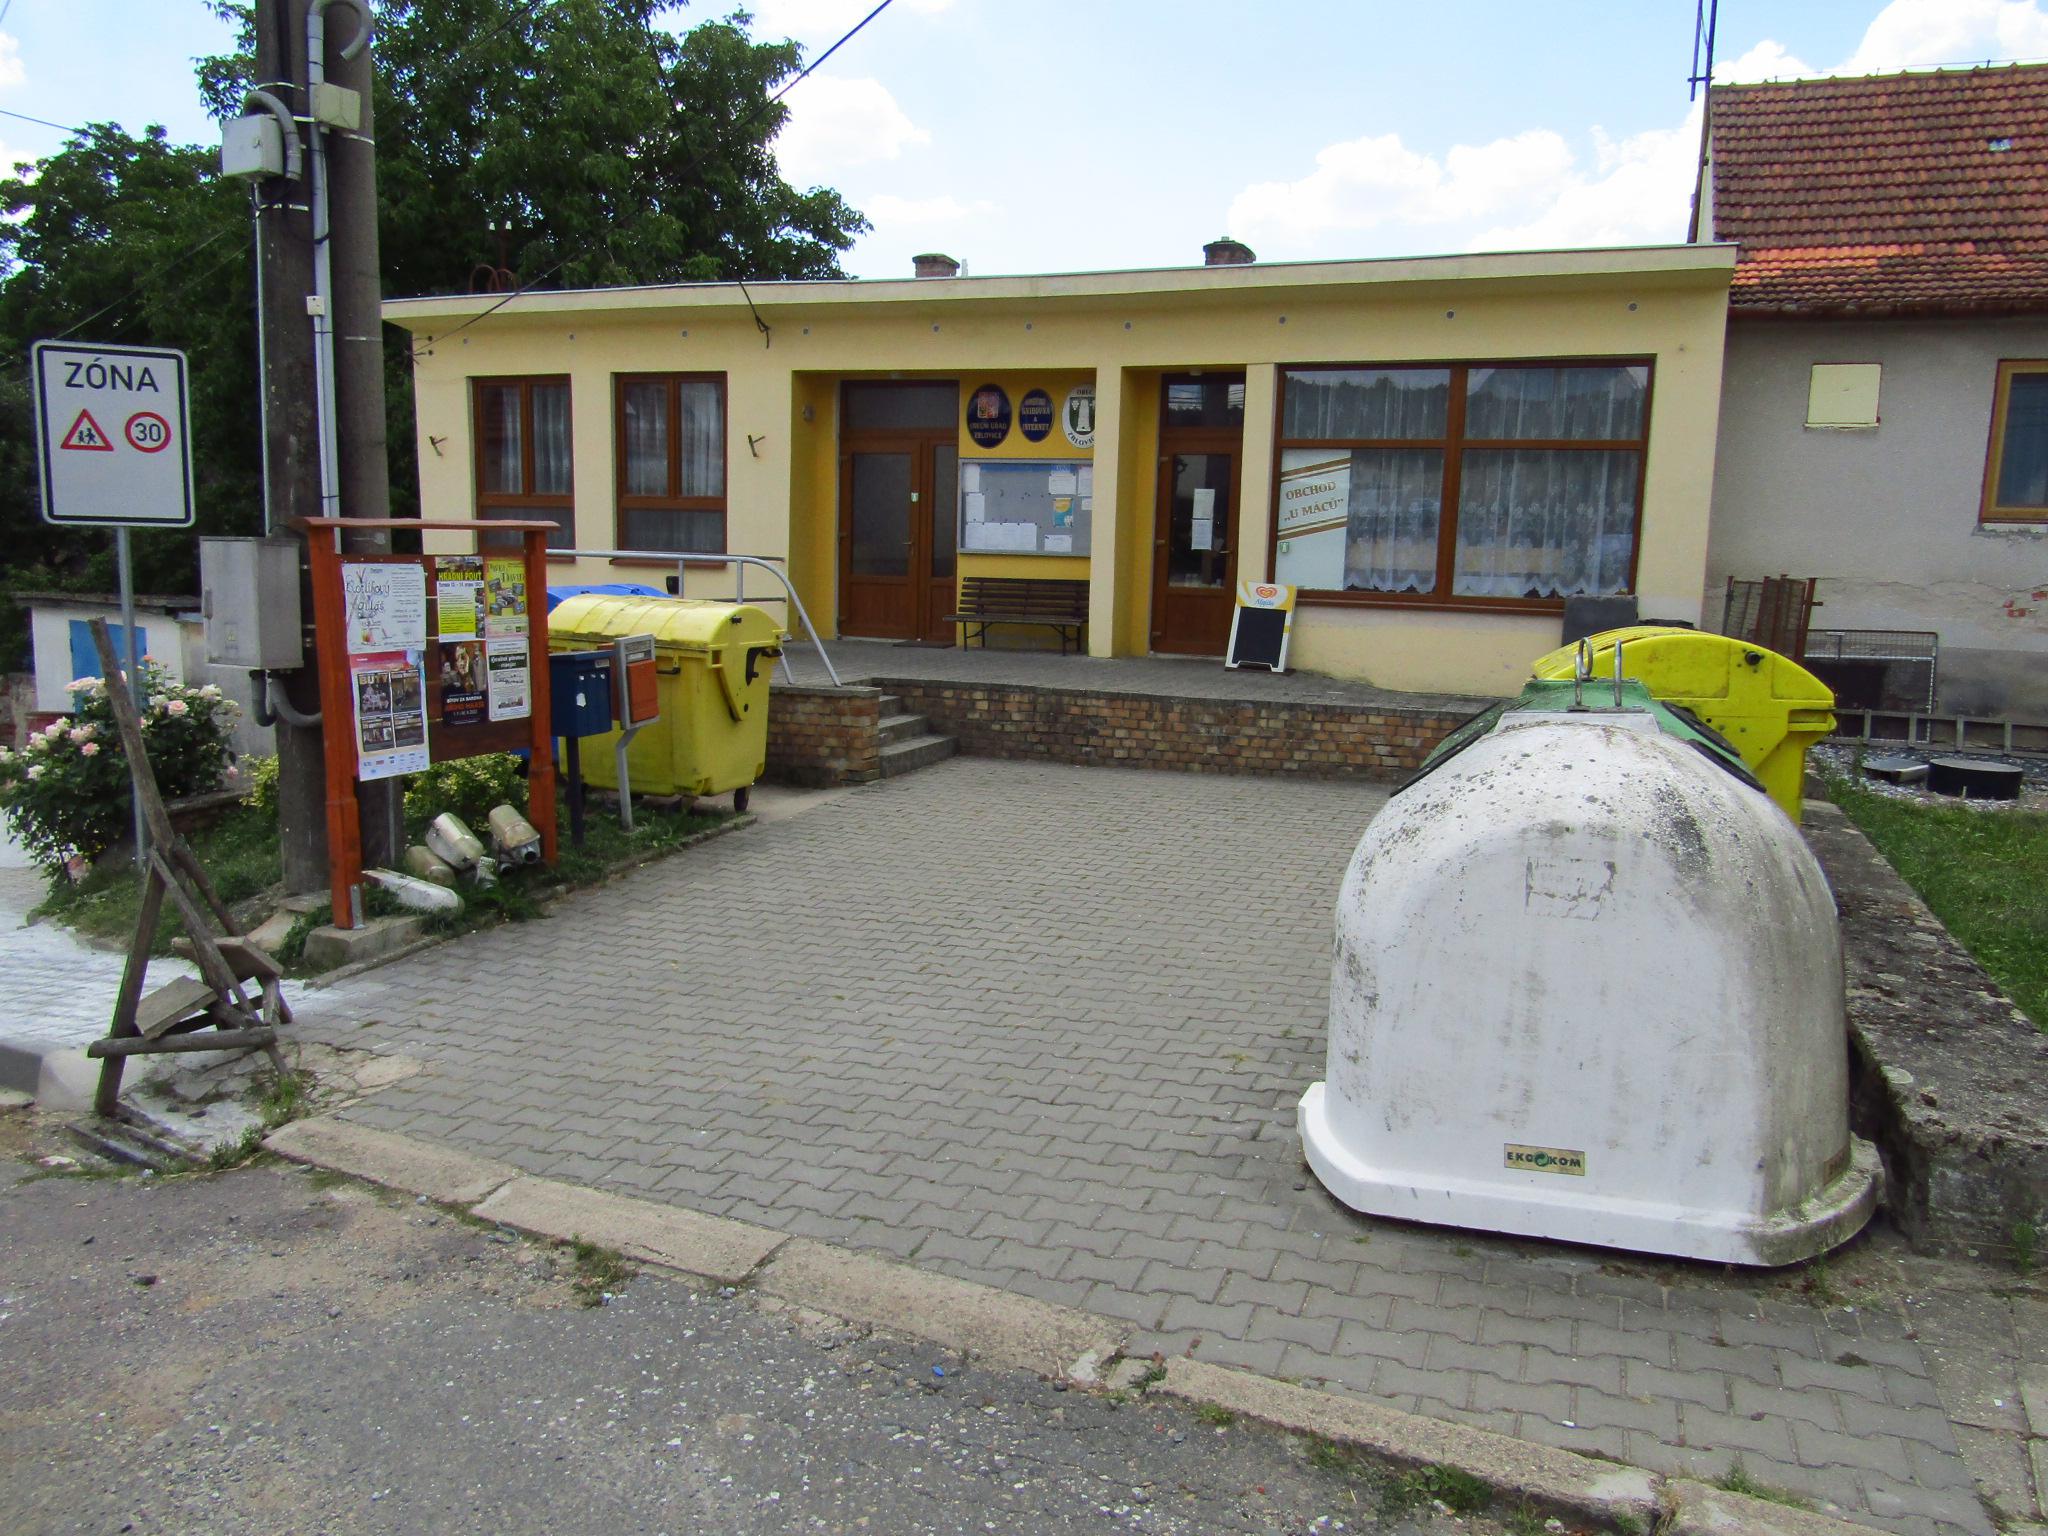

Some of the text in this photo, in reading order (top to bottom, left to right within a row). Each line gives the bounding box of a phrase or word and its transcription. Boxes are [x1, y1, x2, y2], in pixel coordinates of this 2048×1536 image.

[64, 357, 159, 392] ZÓNA
[135, 423, 162, 442] 30
[1067, 432, 1095, 446] ZBLOVIC
[1286, 482, 1336, 500] OBCHOD
